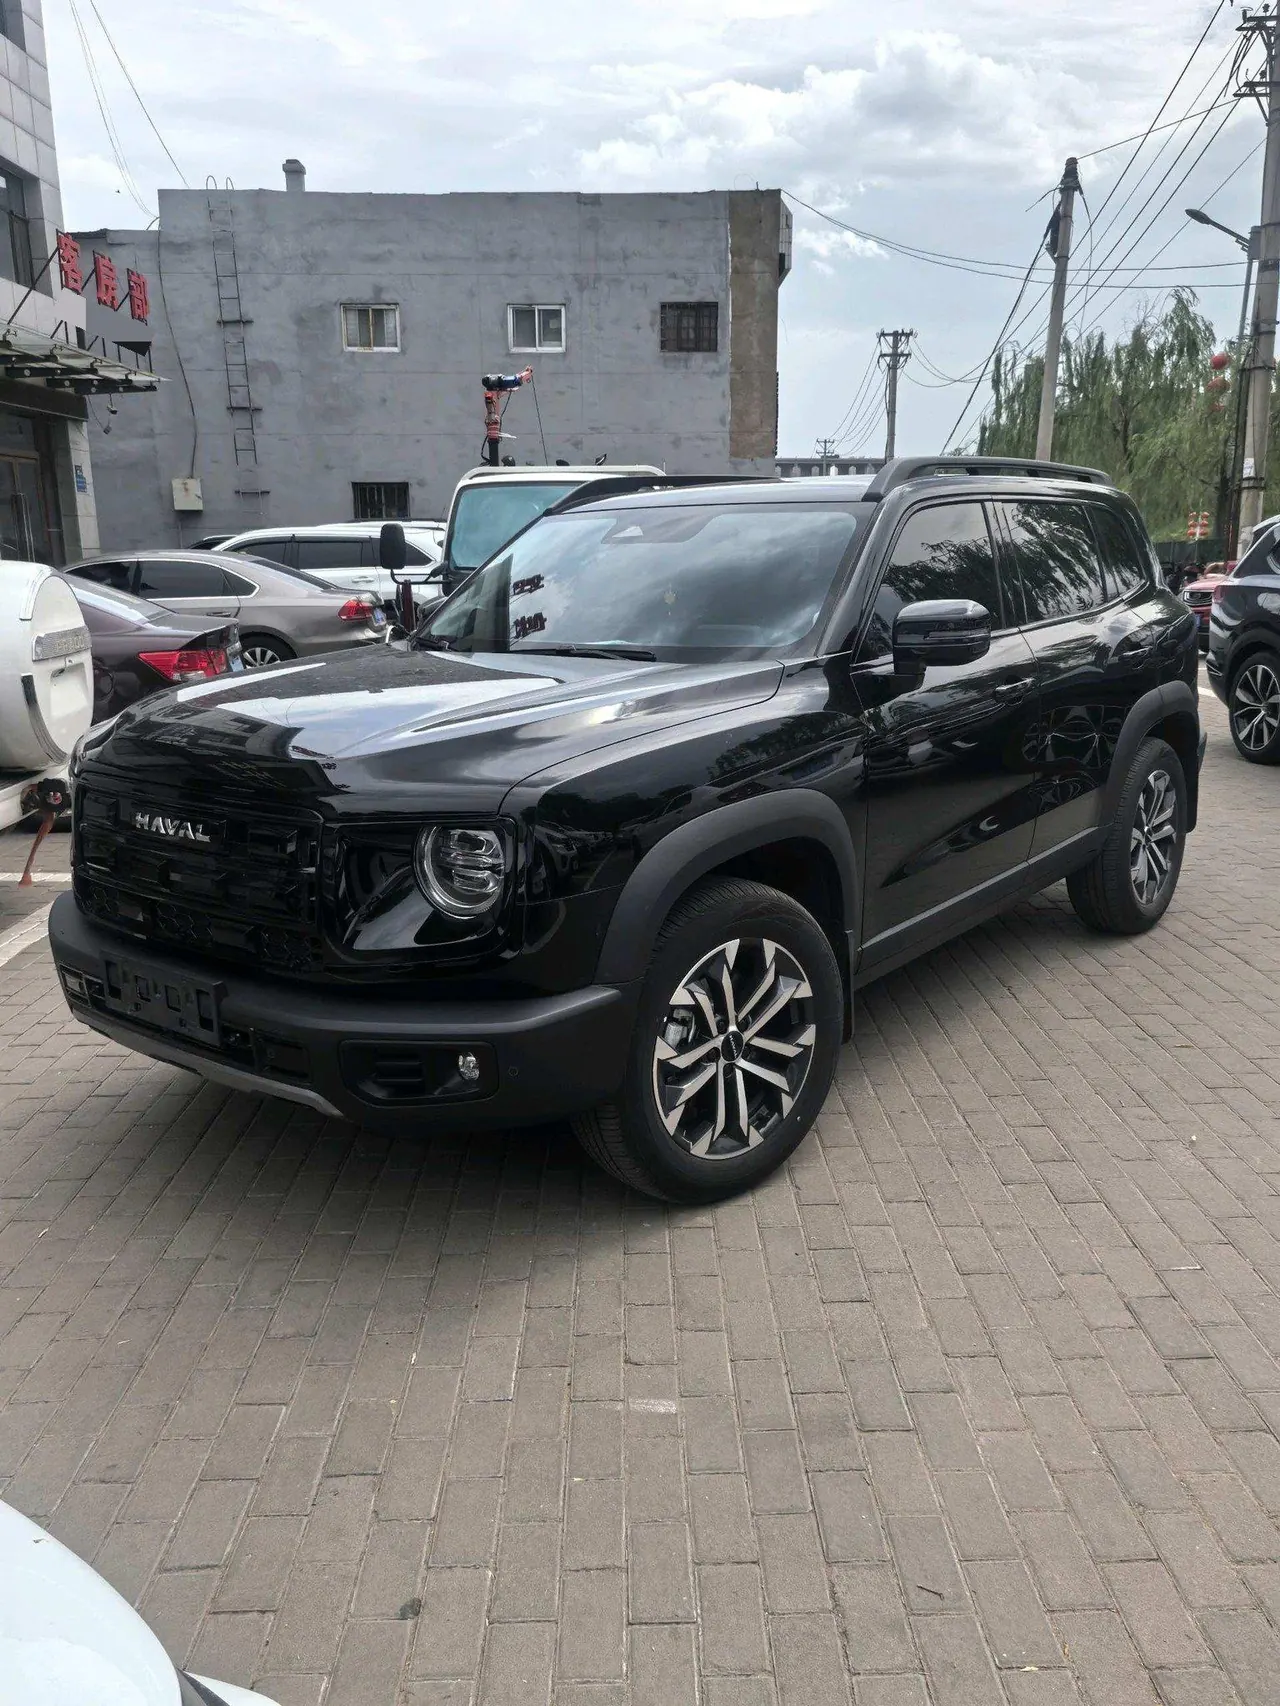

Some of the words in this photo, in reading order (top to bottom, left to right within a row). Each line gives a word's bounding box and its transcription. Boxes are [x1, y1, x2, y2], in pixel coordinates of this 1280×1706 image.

[58, 232, 149, 321] 客房部
[135, 812, 211, 843] HAVAL
